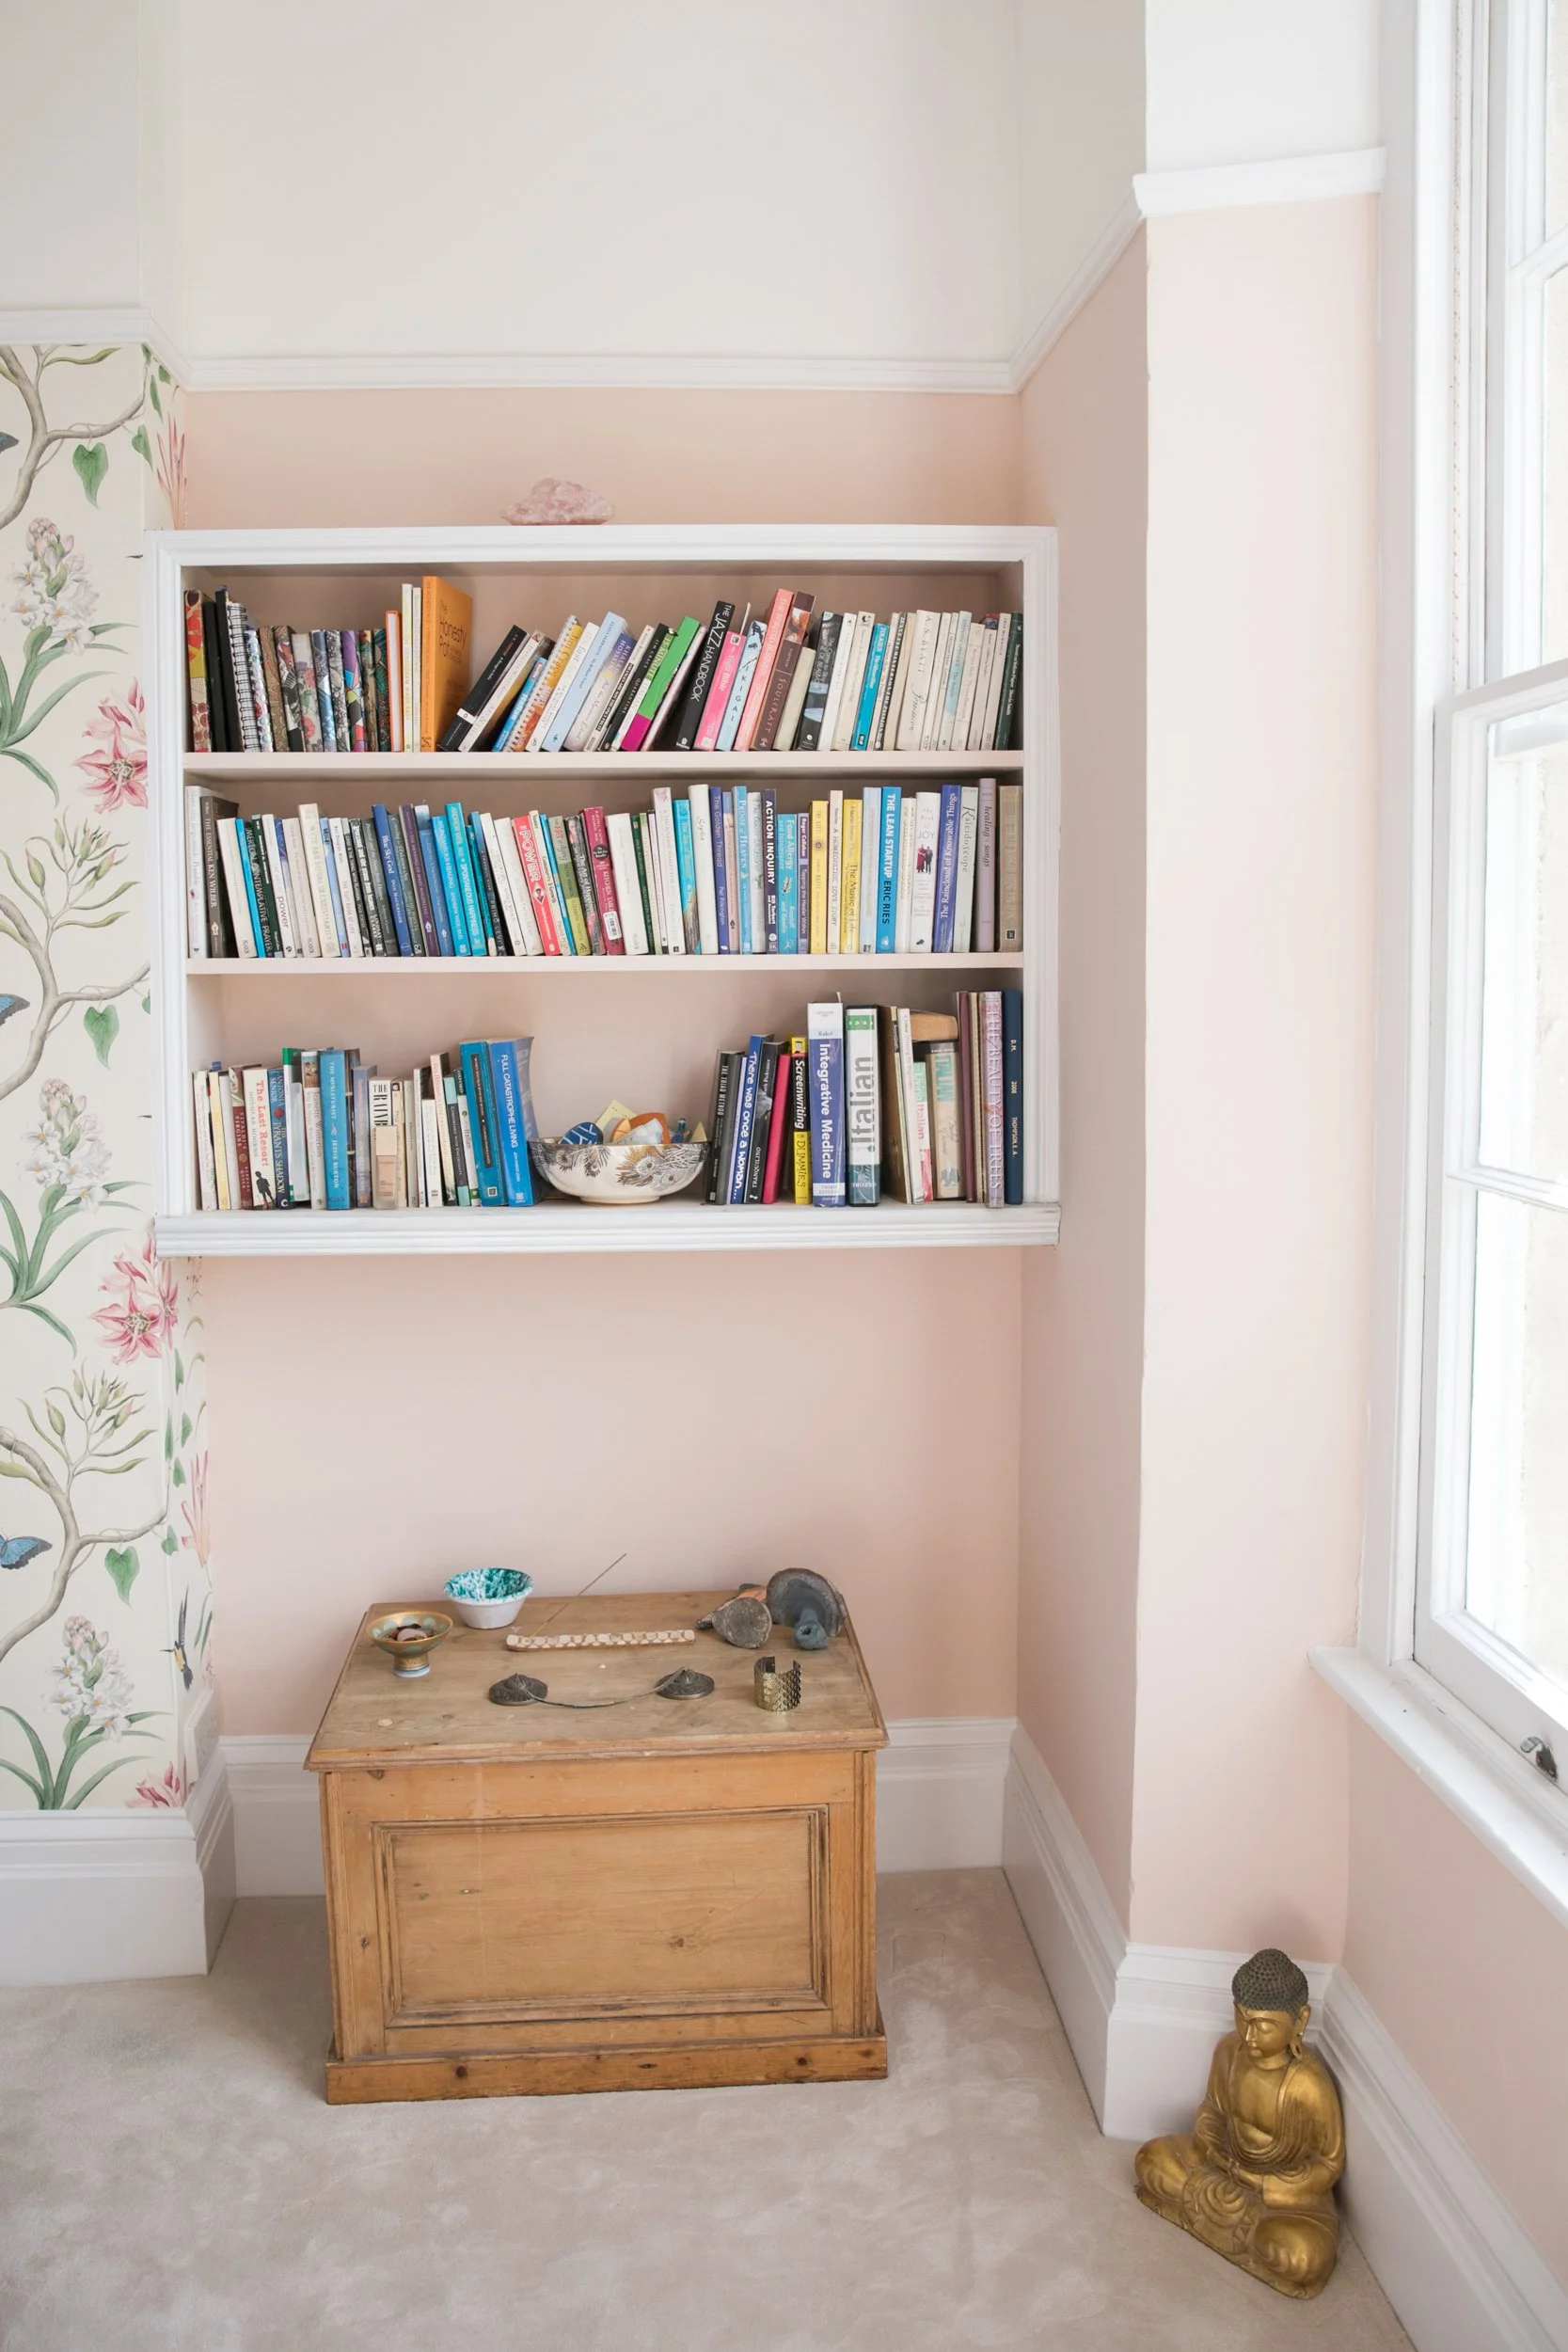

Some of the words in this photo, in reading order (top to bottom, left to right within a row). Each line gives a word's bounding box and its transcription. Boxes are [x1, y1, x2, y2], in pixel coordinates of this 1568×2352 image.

[722, 605, 732, 616] THE
[439, 615, 467, 650] Honesty
[707, 613, 727, 647] JAZZ
[438, 635, 451, 658] Pot
[690, 646, 715, 702] HANDBOOK
[719, 673, 731, 691] Bible
[621, 678, 641, 714] QUARANTINE
[764, 678, 785, 733] SOULCRAFT
[738, 800, 747, 825] PROOF
[887, 794, 895, 811] THE
[946, 793, 958, 818] Things
[766, 801, 774, 839] ACTION
[886, 813, 895, 837] LEAN
[982, 806, 992, 838] healing
[917, 832, 936, 840] JOY
[944, 819, 955, 856] Knowable
[960, 806, 975, 872] Kaleidoscope
[383, 849, 391, 860] Sky
[519, 830, 541, 883] POWER
[766, 842, 775, 884] INQUIRY
[784, 841, 794, 869] Allergy
[884, 839, 894, 878] STARTUP
[944, 856, 953, 865] of
[209, 881, 217, 907] WILBER
[942, 866, 952, 902] Raincloud
[276, 896, 289, 929] power
[490, 900, 499, 923] PRIMO
[718, 898, 726, 925] Pilkington
[849, 908, 856, 916] of
[882, 903, 891, 924] RIES
[940, 902, 949, 918] The
[263, 926, 272, 951] PRAYER
[987, 1009, 1000, 1041] THE
[500, 1055, 509, 1072] FULL
[747, 1051, 757, 1085] There
[256, 1080, 265, 1102] The
[270, 1077, 278, 1104] SENIOR
[276, 1074, 285, 1106] ANTONIA
[372, 1084, 388, 1093] THE
[720, 1076, 728, 1092] TRIAD
[816, 1043, 832, 1116] Integrative
[987, 1048, 1002, 1108] BEAUTY
[312, 1091, 322, 1119] Jeanette
[503, 1073, 515, 1123] CATASTROPHE
[717, 1094, 727, 1116] METHOD
[744, 1087, 753, 1107] was
[795, 1059, 806, 1129] Screenwriting
[849, 1056, 875, 1144] Italian
[258, 1105, 266, 1128] Last
[372, 1094, 388, 1127] RAINB
[741, 1111, 751, 1137] once
[314, 1120, 323, 1157] Winterson
[509, 1125, 518, 1148] LIVING
[989, 1114, 1003, 1136] OF
[260, 1132, 270, 1167] Resort
[820, 1119, 832, 1179] Medicine
[276, 1160, 285, 1193] SHADOW
[990, 1144, 1004, 1190] TREES
